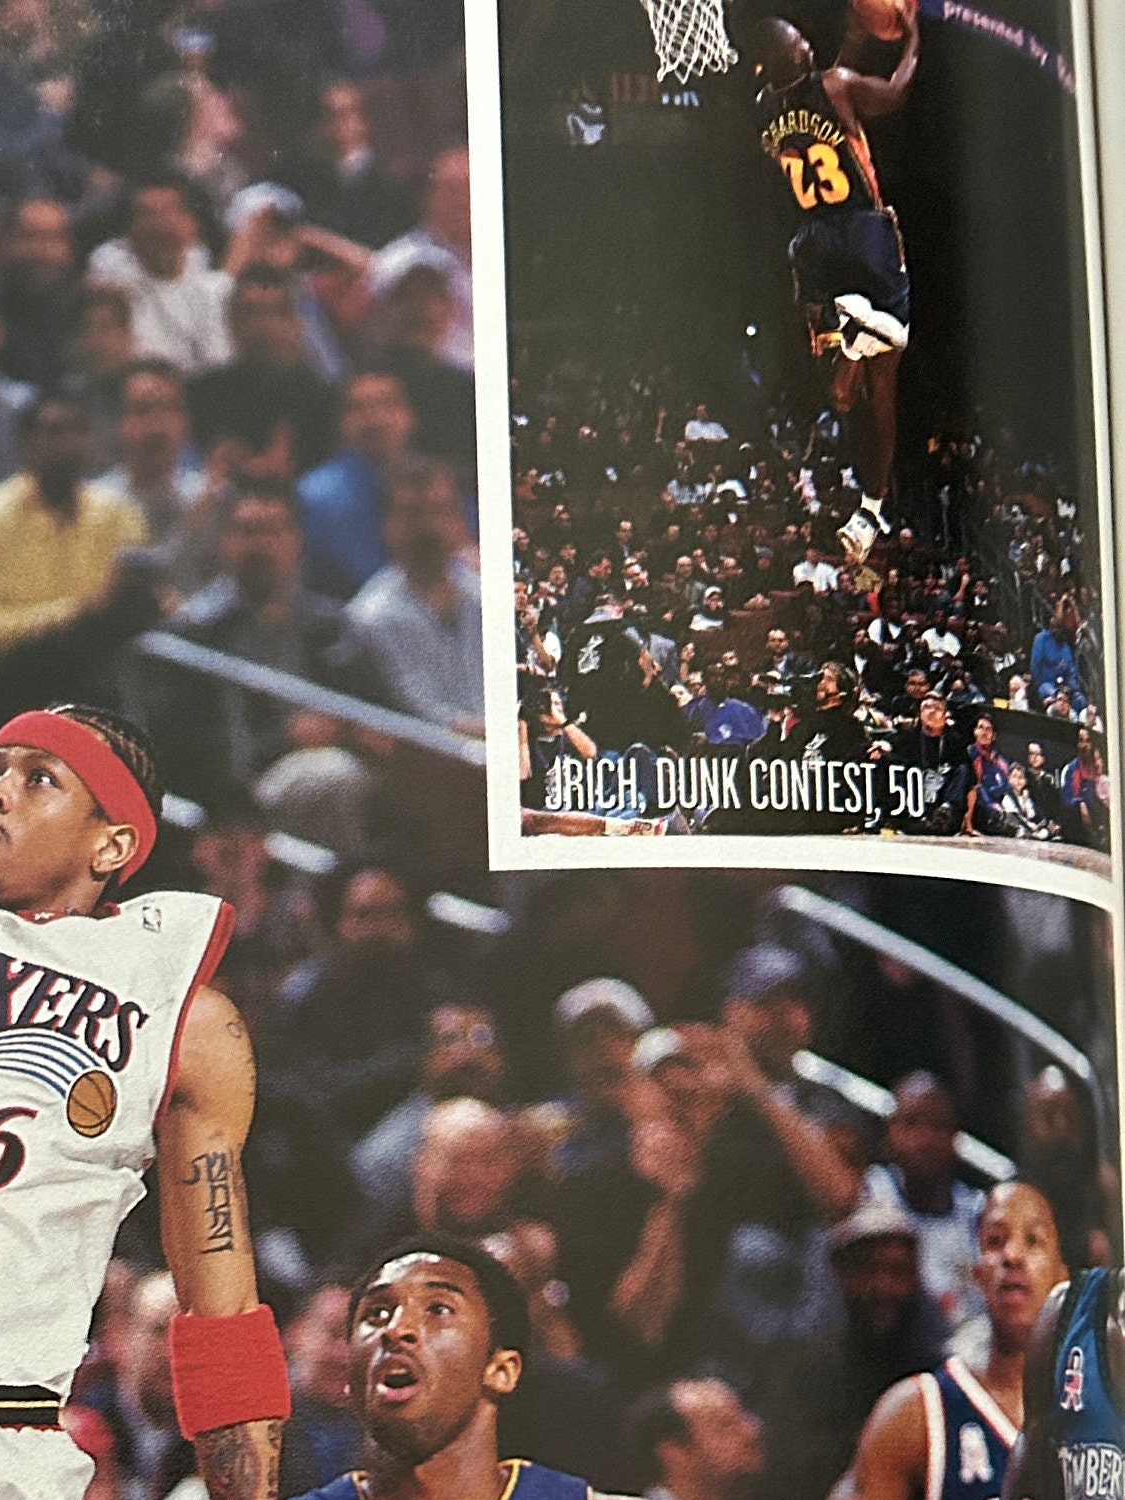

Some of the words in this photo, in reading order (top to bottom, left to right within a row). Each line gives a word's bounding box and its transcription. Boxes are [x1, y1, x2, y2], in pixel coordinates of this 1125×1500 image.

[780, 143, 850, 210] 23
[543, 756, 647, 814] JRICH,
[656, 756, 741, 811] DUNK
[750, 757, 883, 822] CONTEST,
[888, 764, 924, 818] 50
